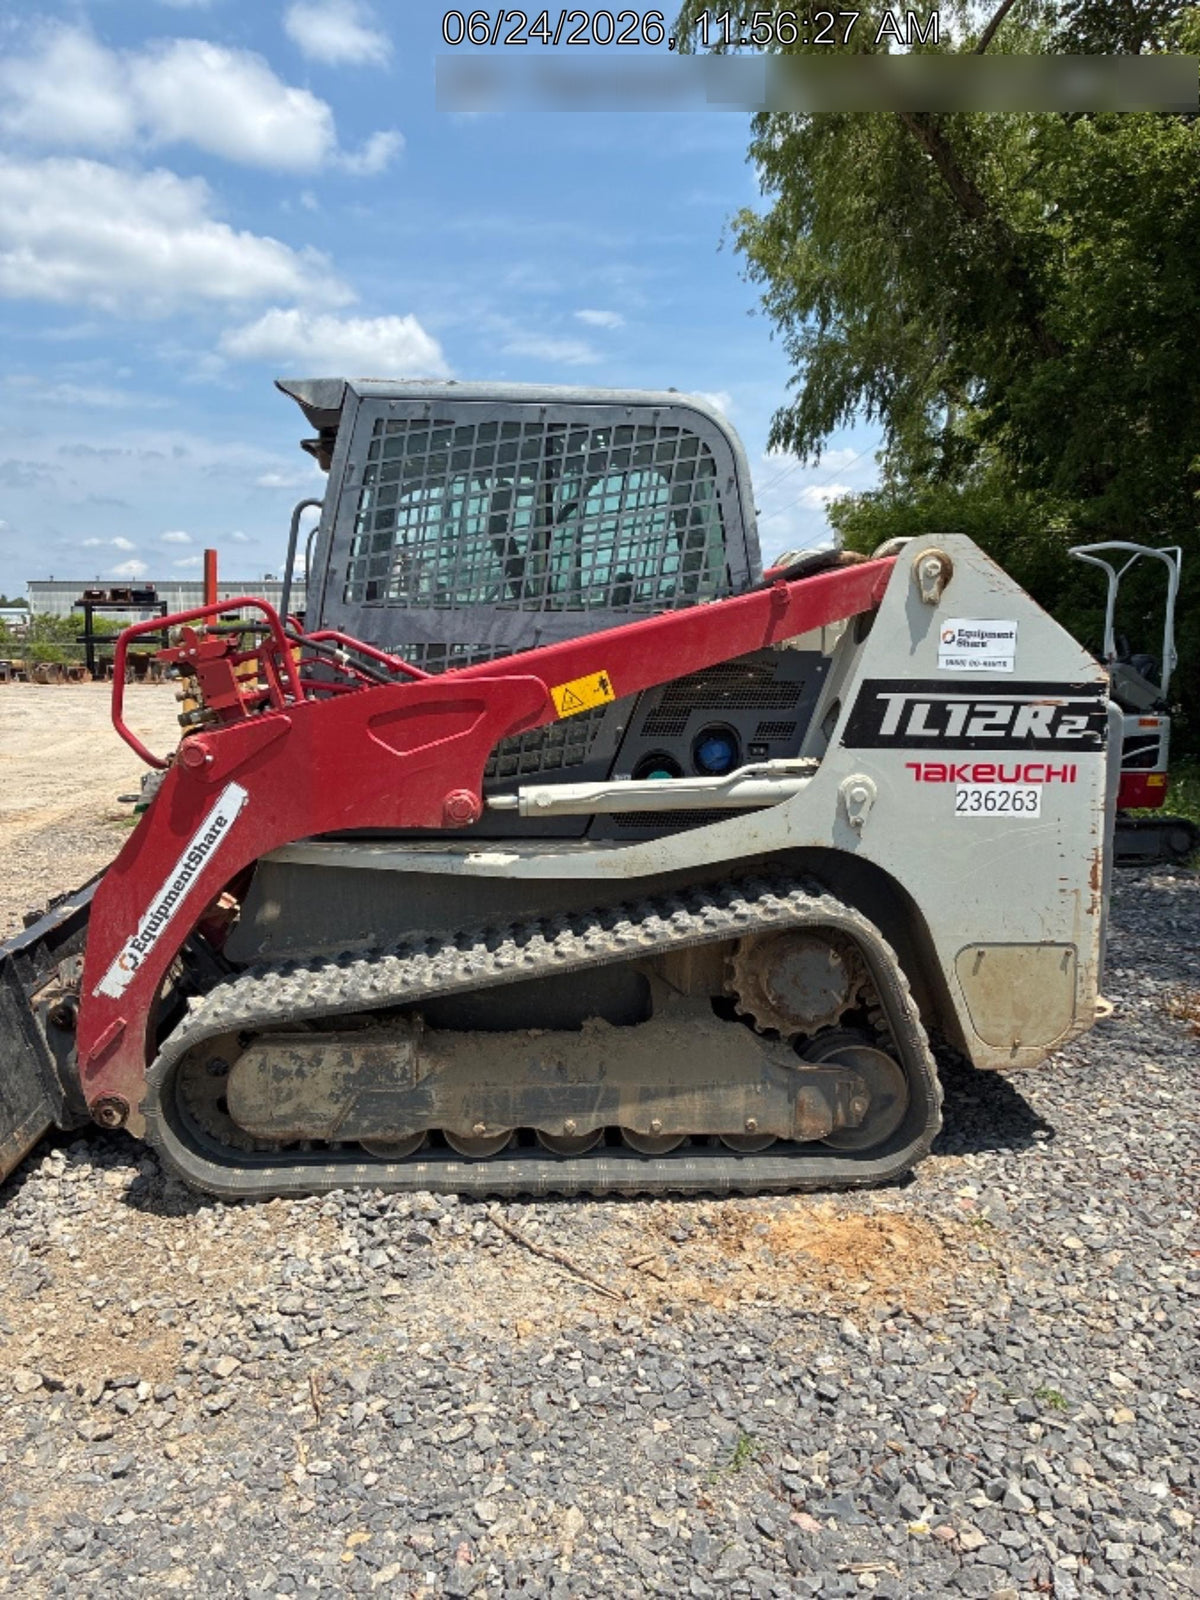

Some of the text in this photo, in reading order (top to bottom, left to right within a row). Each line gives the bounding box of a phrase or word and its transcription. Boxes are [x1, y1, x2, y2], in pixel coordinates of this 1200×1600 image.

[956, 638, 988, 648] Share
[957, 628, 1015, 640] Equipment
[876, 693, 1098, 739] TL12R2
[956, 790, 1038, 812] 236263
[129, 814, 228, 953] EquipmentShare
